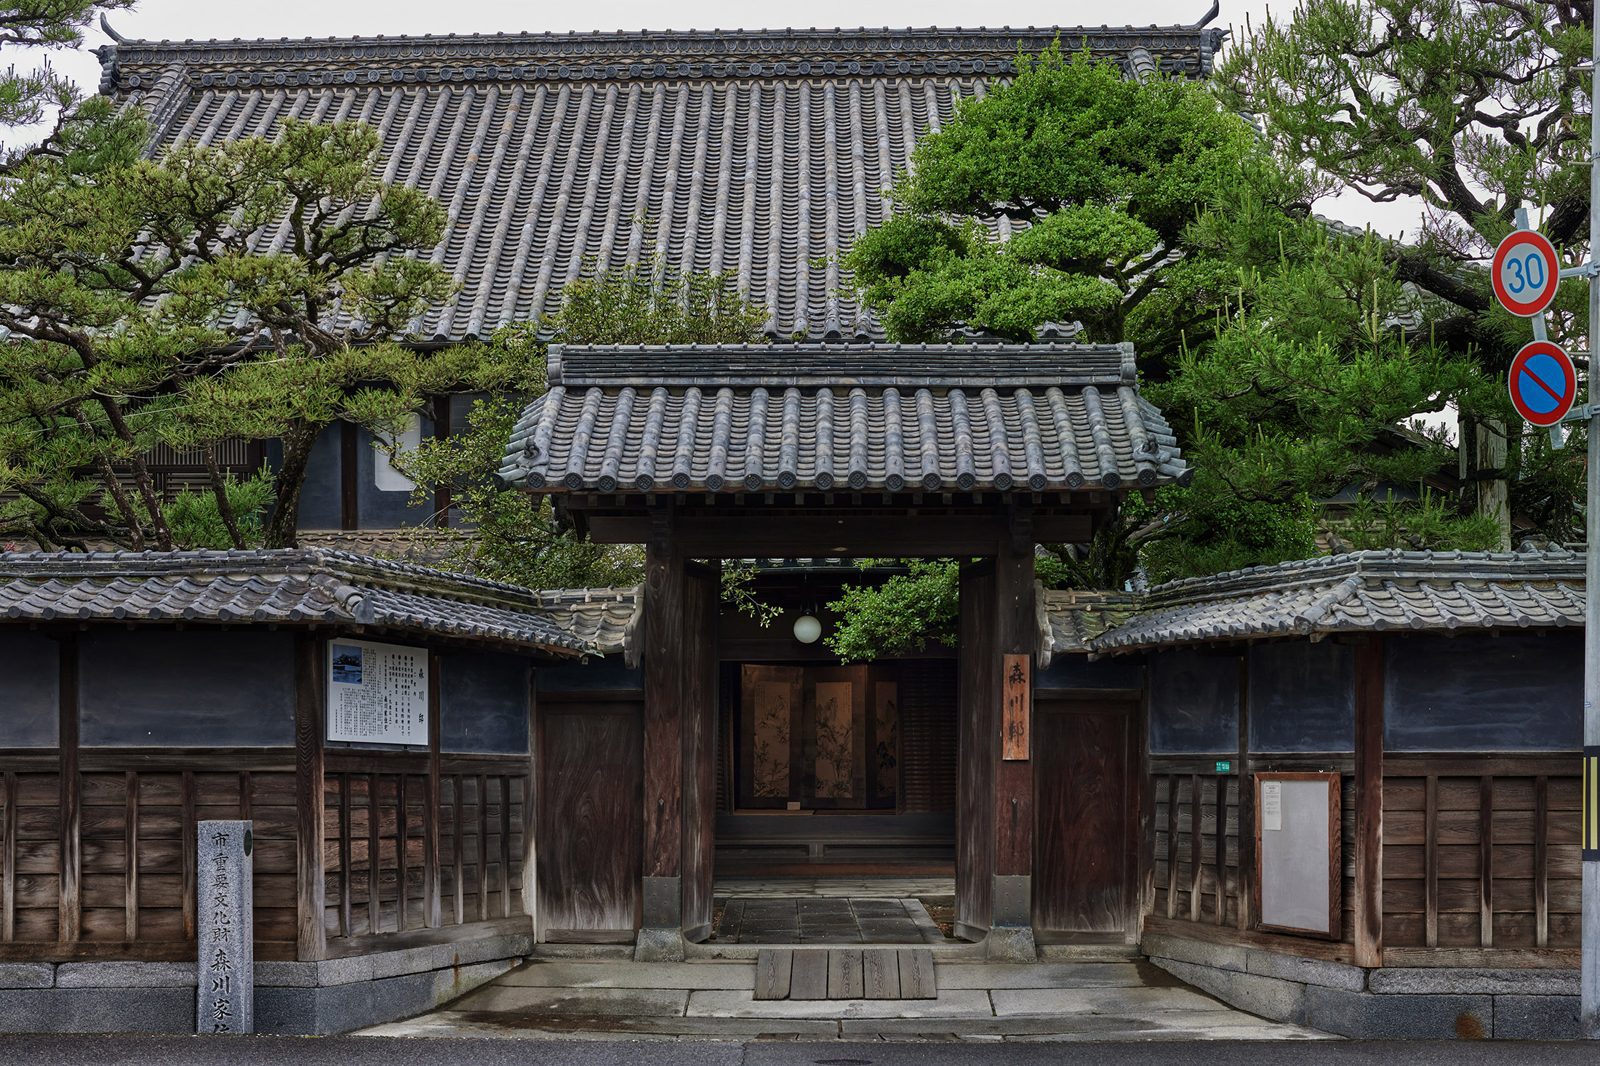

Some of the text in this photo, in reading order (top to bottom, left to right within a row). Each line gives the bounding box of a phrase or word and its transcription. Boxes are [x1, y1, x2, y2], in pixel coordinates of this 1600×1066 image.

[1506, 252, 1544, 294] 30
[211, 831, 231, 943] 市重要文化財
